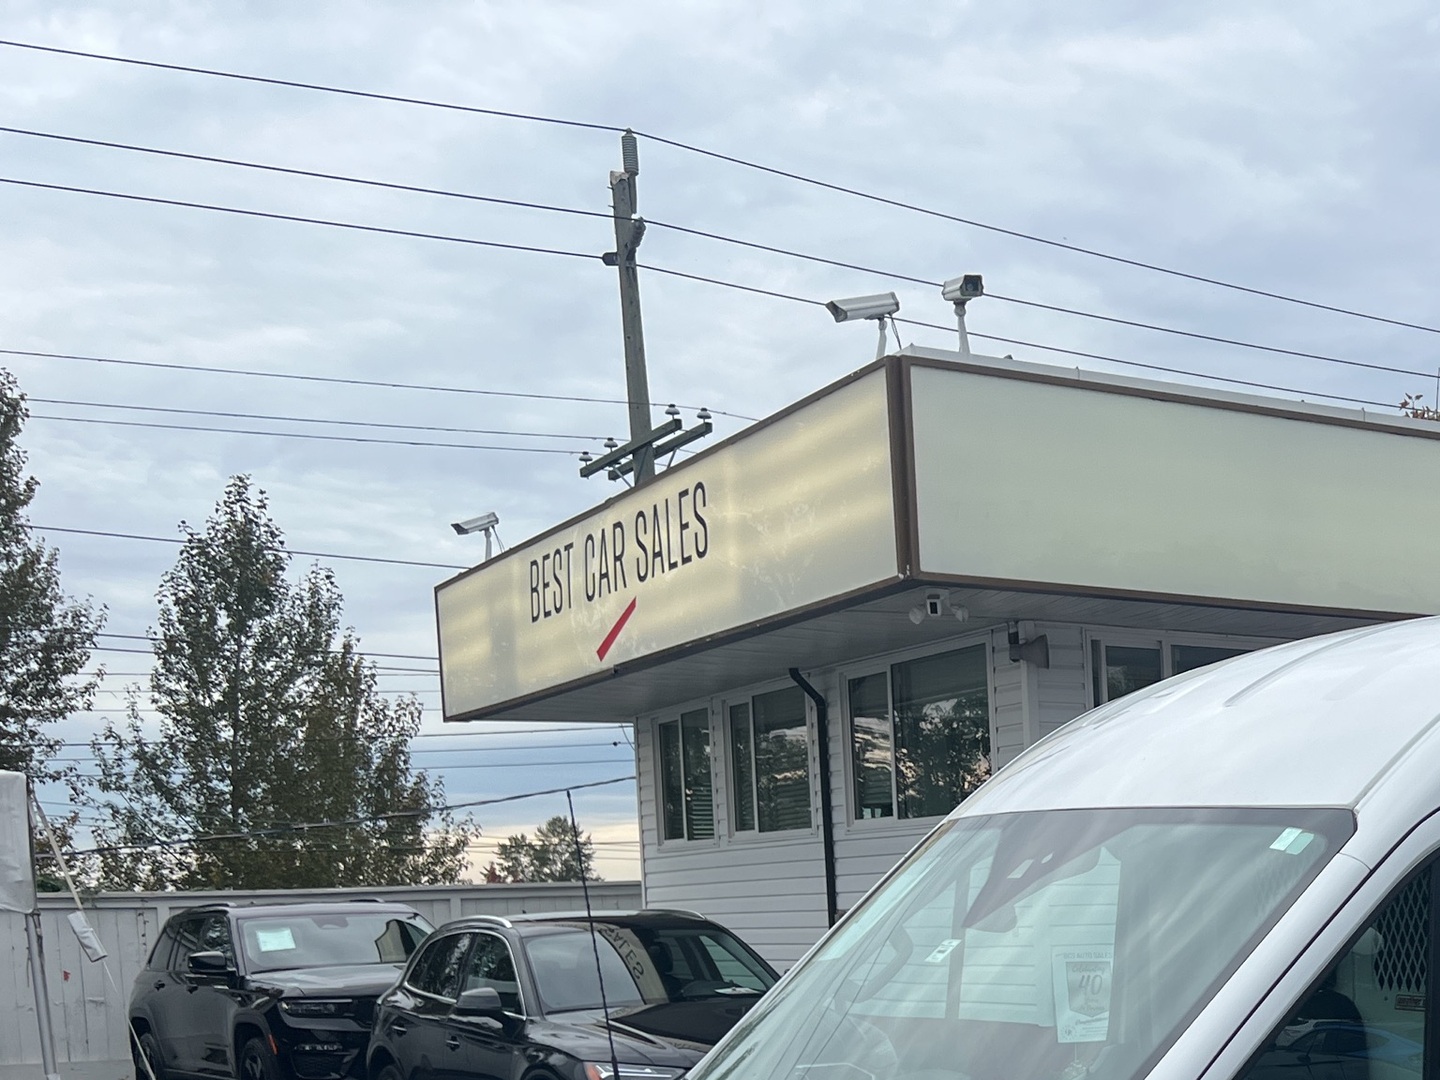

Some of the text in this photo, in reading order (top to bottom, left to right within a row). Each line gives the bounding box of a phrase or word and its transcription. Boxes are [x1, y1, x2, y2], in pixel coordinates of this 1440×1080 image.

[530, 481, 708, 623] BEST CAR SALES
[1079, 974, 1102, 995] 40
